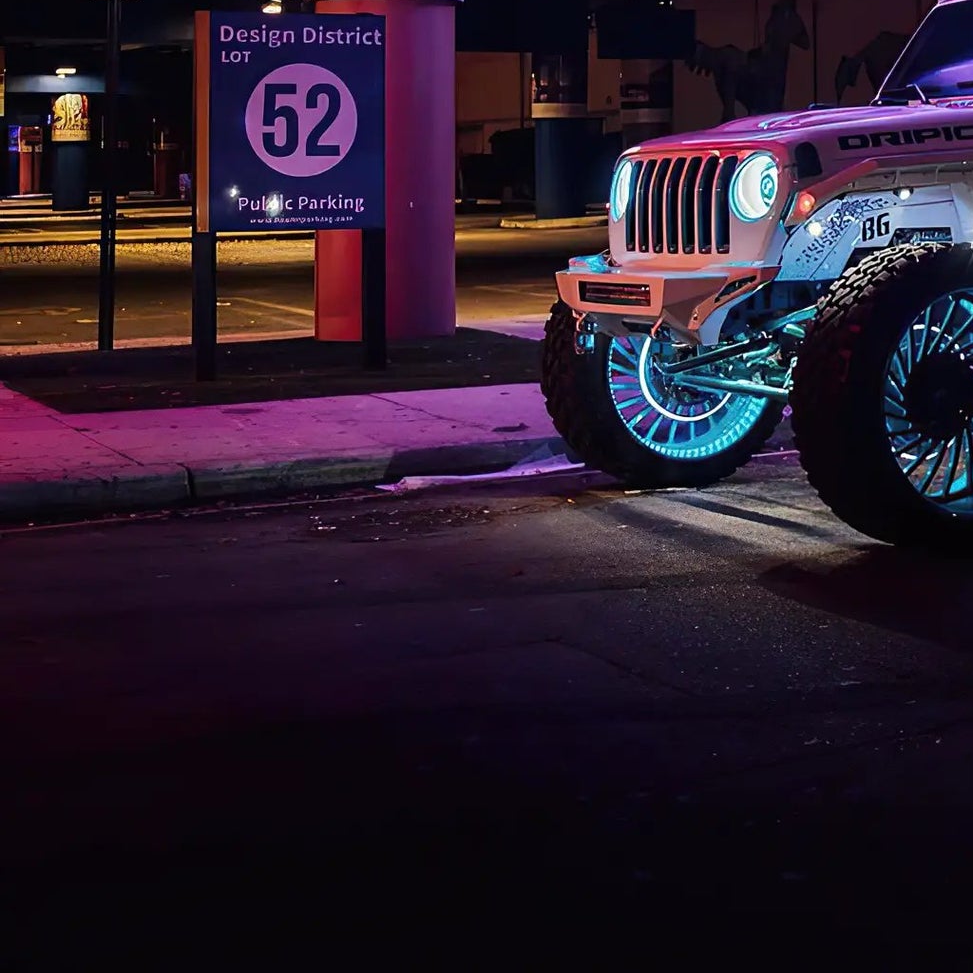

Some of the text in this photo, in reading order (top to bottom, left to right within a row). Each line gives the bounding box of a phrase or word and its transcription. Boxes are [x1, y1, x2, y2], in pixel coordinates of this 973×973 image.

[219, 24, 383, 48] Design District
[221, 50, 252, 63] LOT
[262, 83, 342, 158] 52
[238, 193, 365, 213] Puic Parking
